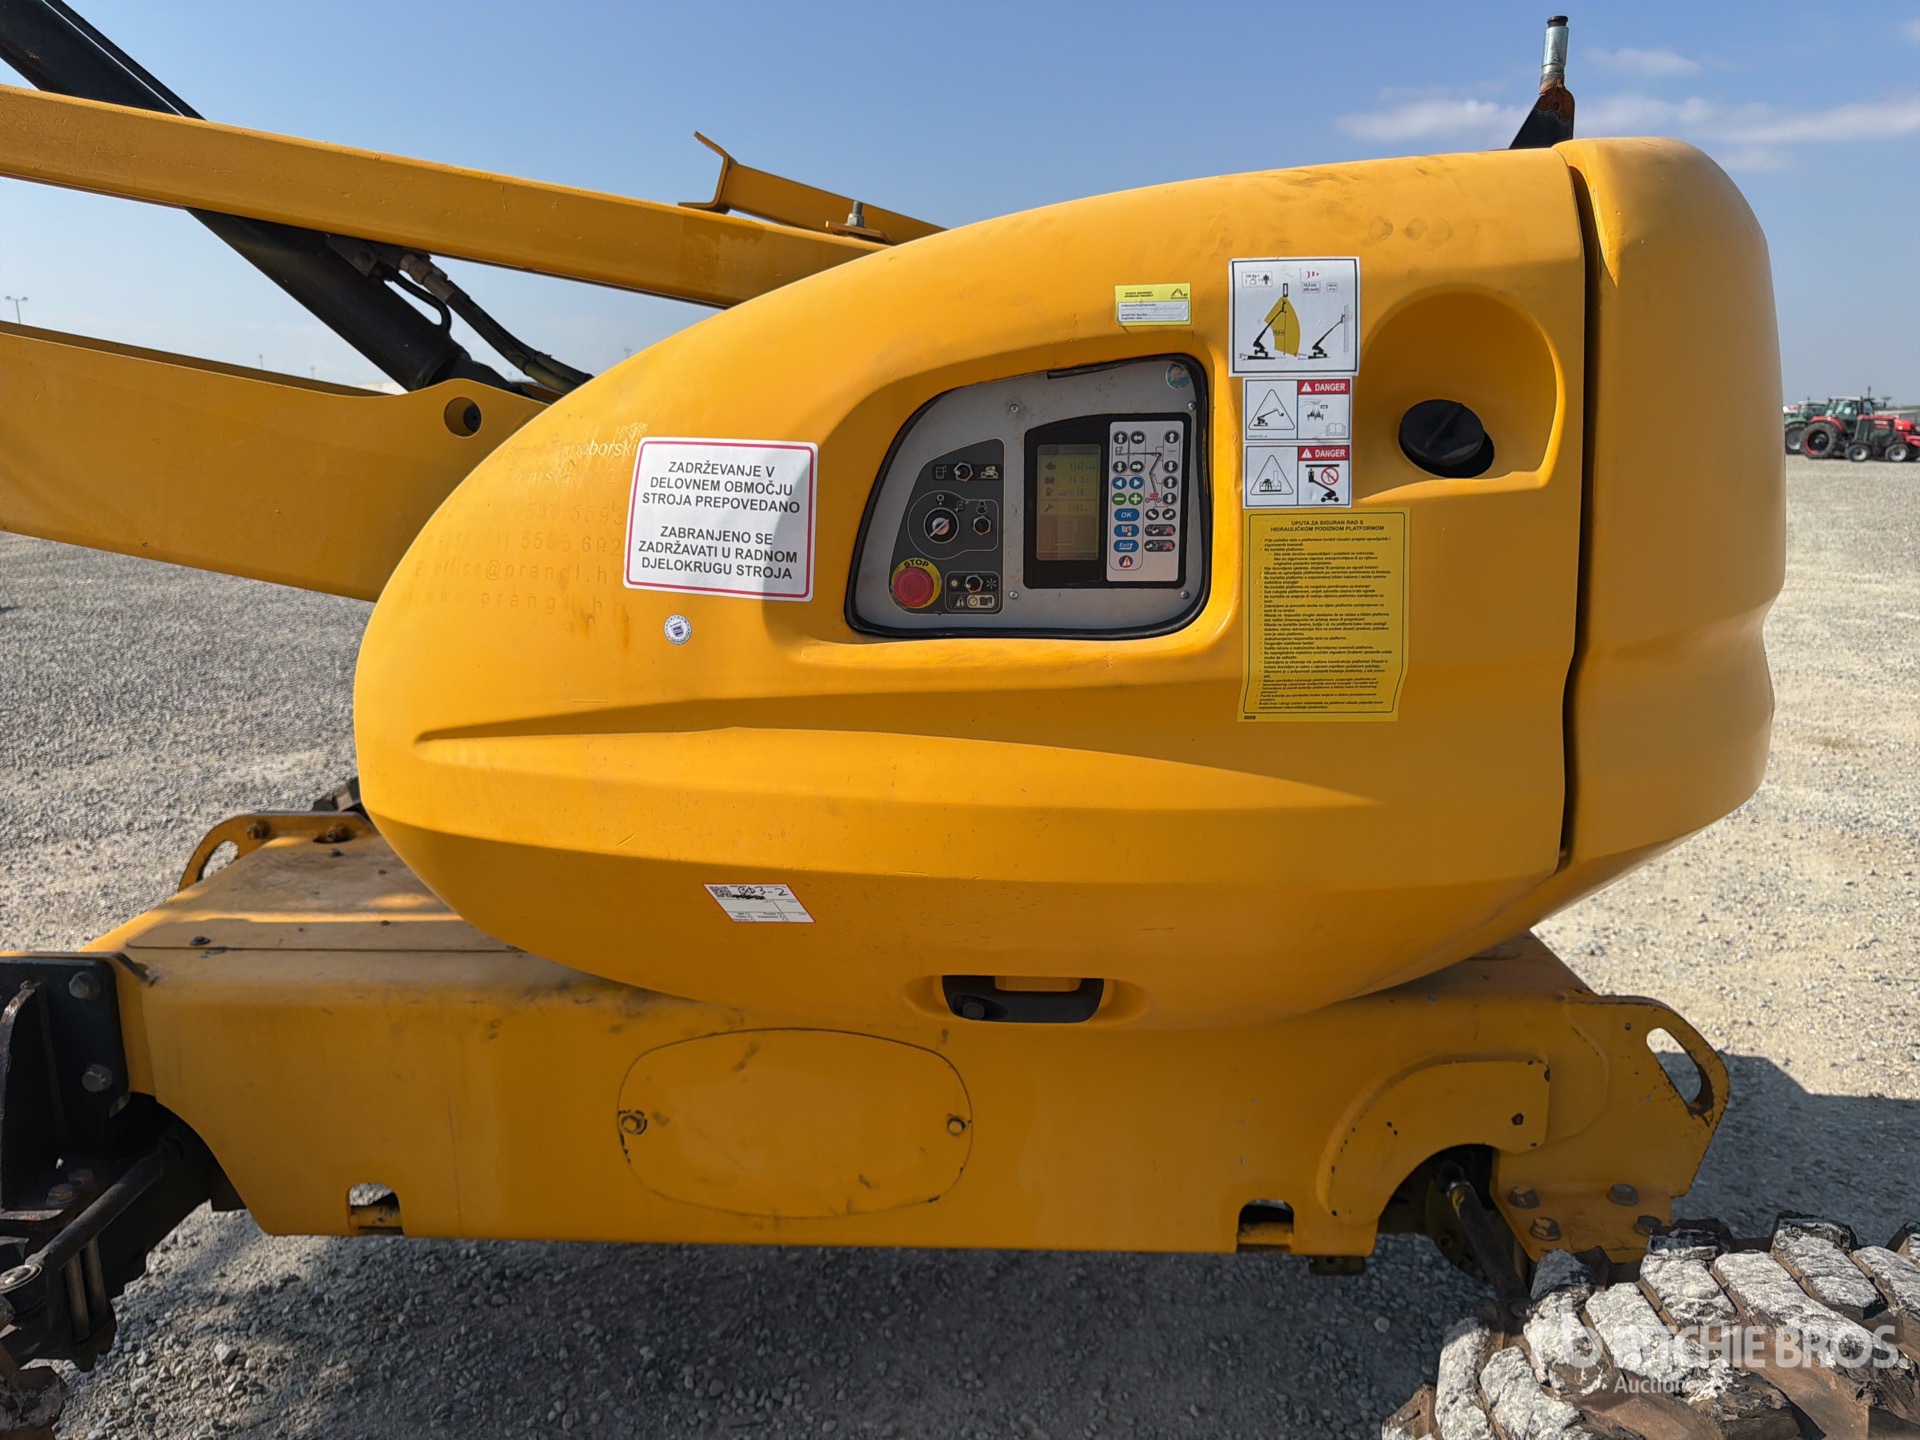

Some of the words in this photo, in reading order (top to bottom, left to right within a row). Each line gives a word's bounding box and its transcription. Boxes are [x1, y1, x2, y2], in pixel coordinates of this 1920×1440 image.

[1314, 382, 1346, 392] DANGER
[1314, 448, 1346, 458] DANGER
[668, 459, 761, 478] ZADRŽEVANJE
[766, 466, 775, 478] V
[650, 476, 720, 492] DELOVNEM
[724, 480, 793, 496] OBMOČJU
[642, 493, 692, 507] STROJA
[695, 496, 800, 514] PREPOVEDANO
[660, 525, 751, 543] ZABRANJENO
[755, 533, 773, 546] SE
[638, 540, 718, 558] ZADRŽAVATI
[722, 547, 731, 559] U
[735, 548, 797, 563] RADNOM
[641, 556, 732, 575] DJELOKRUGU
[736, 564, 793, 580] STROJA
[903, 559, 930, 568] STOP
